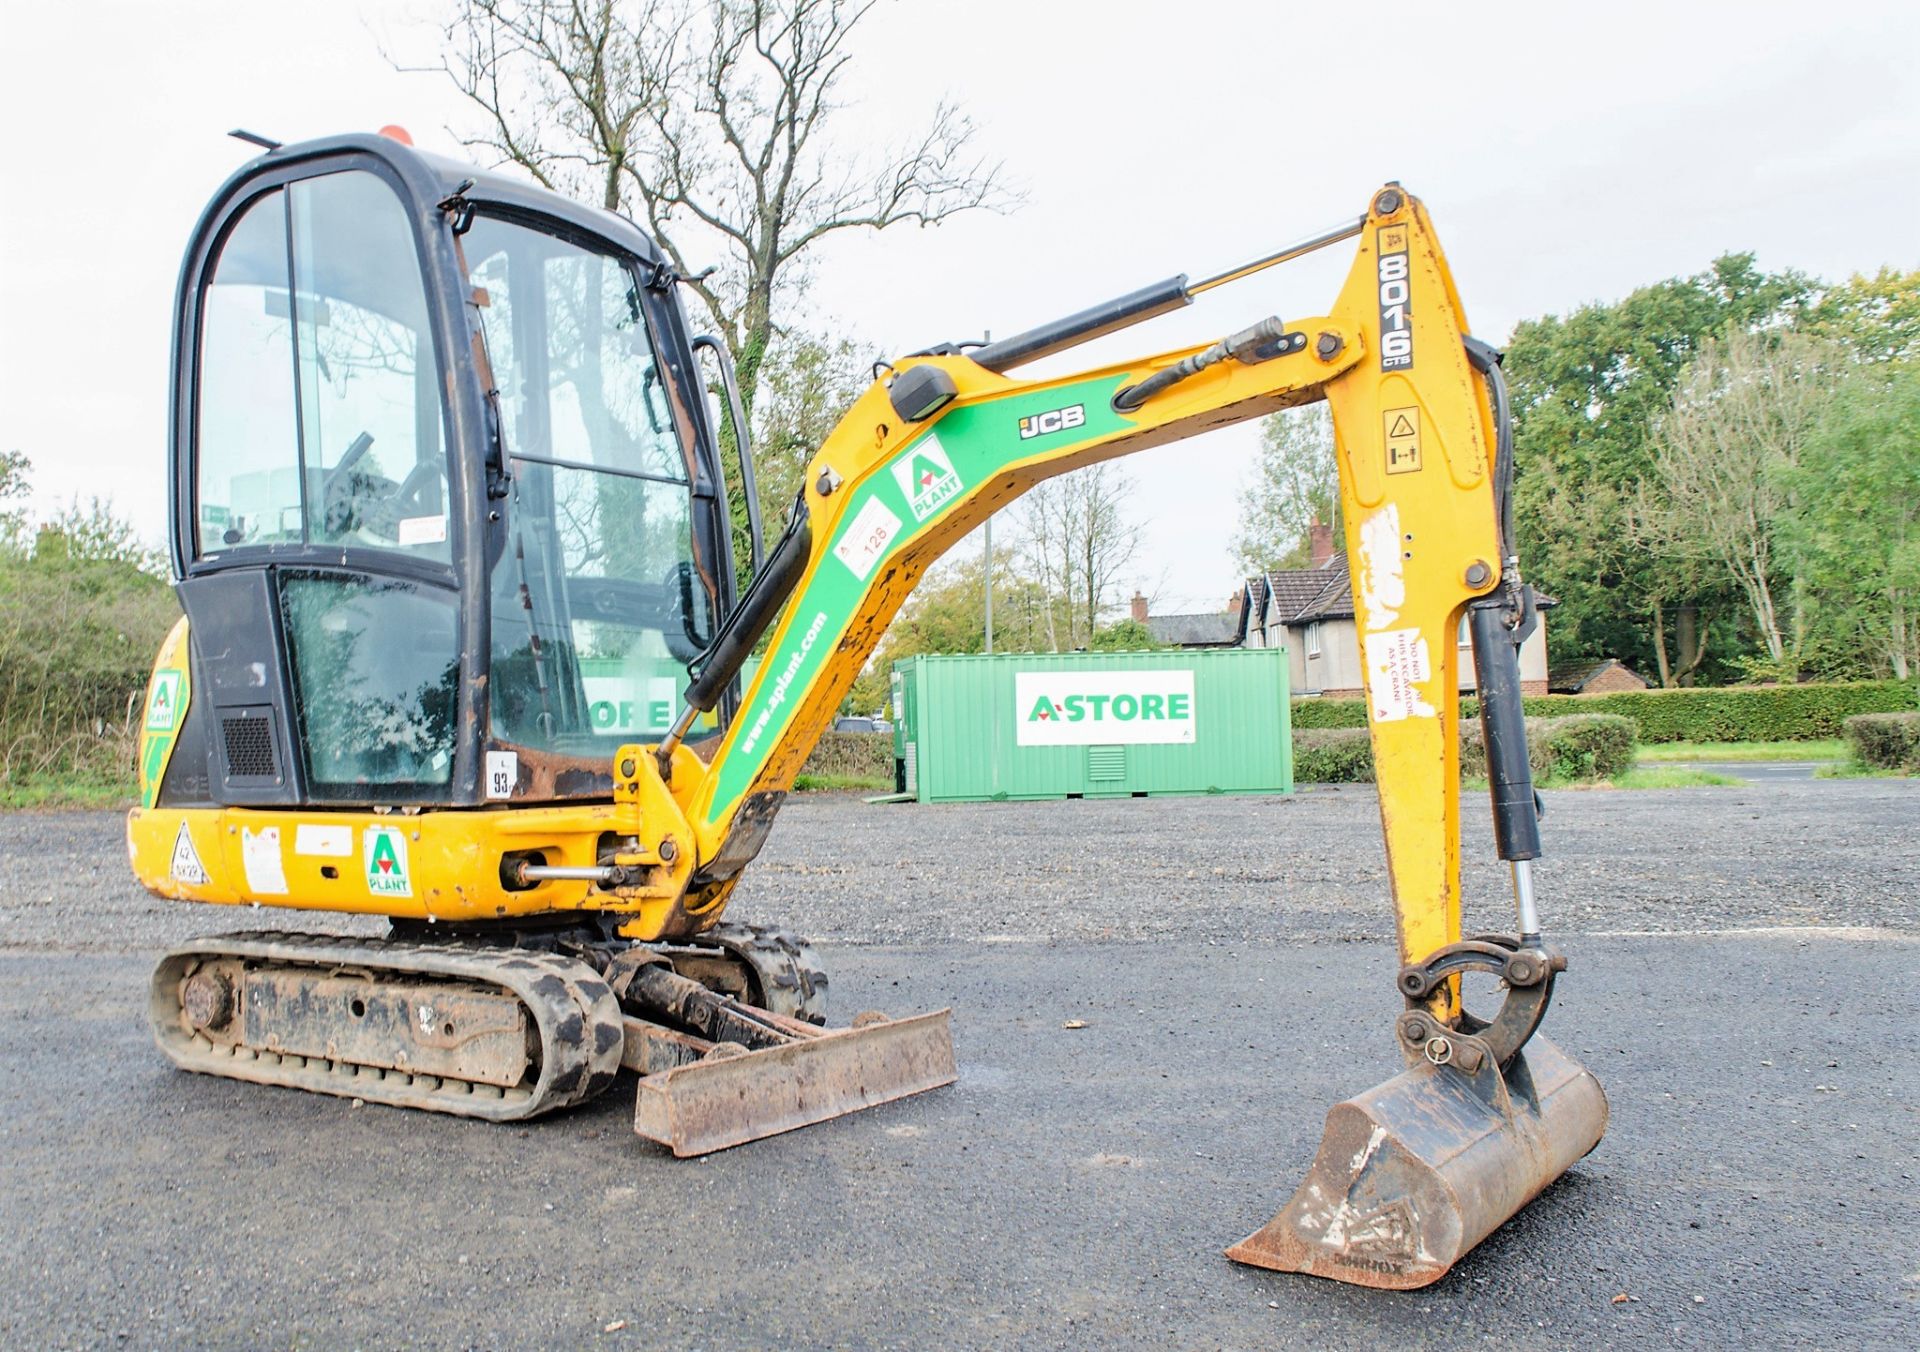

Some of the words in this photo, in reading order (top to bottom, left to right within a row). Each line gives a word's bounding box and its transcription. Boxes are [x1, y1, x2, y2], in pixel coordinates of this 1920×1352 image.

[1379, 254, 1411, 357] 8016
[1020, 405, 1085, 438] JCB
[914, 479, 960, 517] PLANT
[864, 527, 887, 555] 128
[742, 610, 827, 754] www.aplant.com
[1391, 670, 1401, 703] CRANE
[1400, 657, 1413, 715] EXCAVATOR
[369, 878, 408, 891] PLANT
